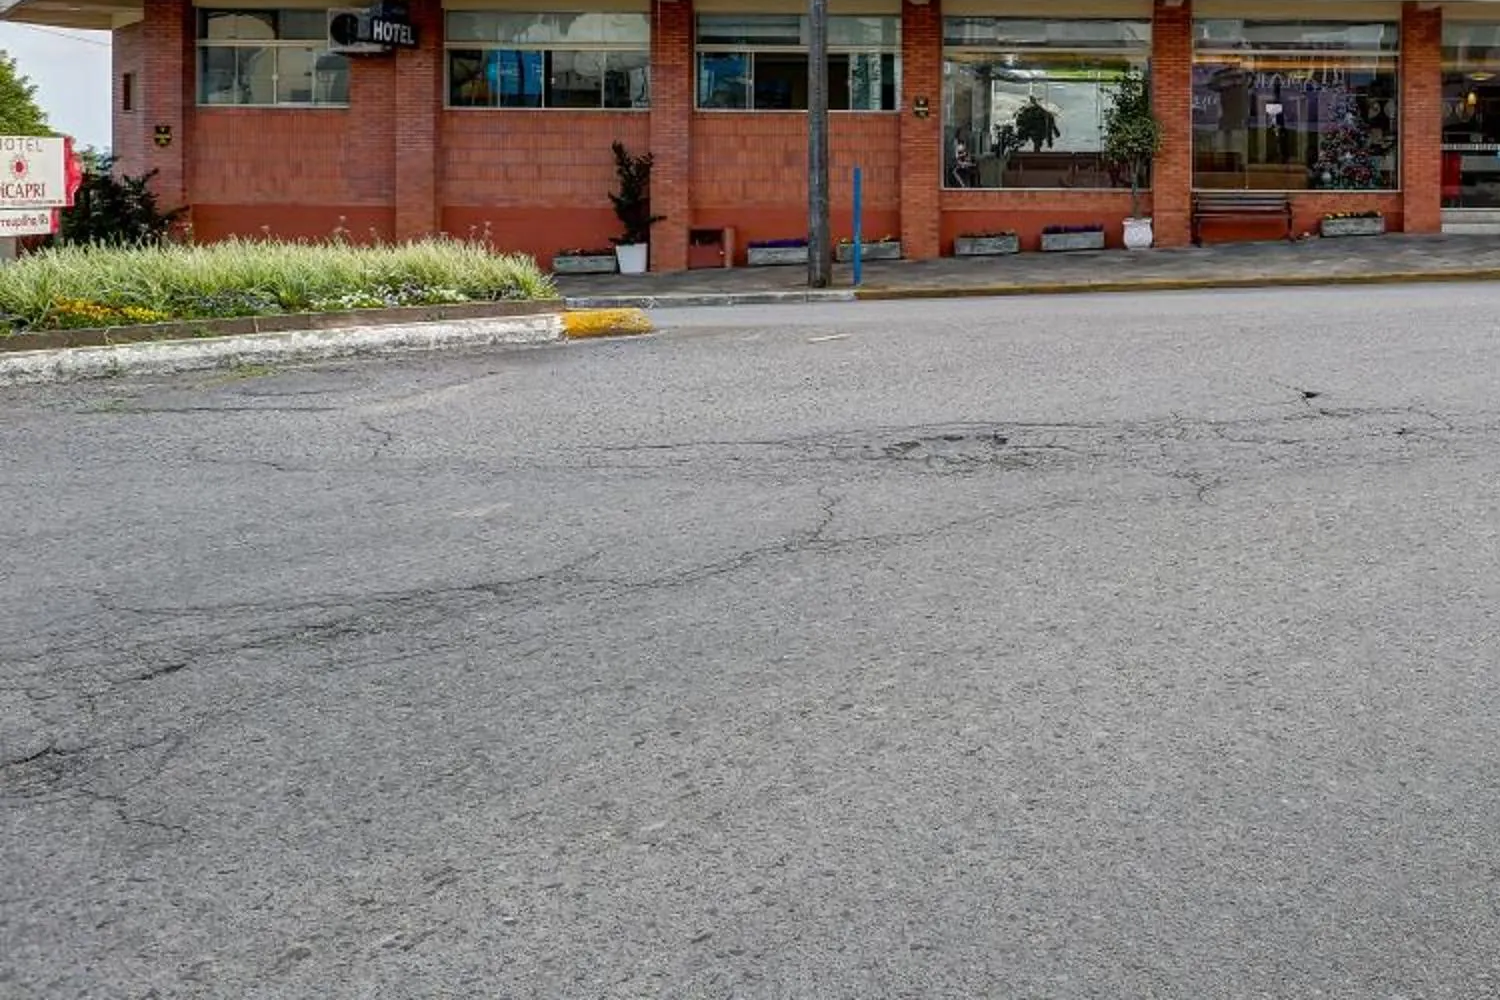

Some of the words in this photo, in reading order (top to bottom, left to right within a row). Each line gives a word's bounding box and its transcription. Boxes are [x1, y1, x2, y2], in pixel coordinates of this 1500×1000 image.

[373, 19, 415, 45] HOTEL
[0, 137, 43, 152] OTEL
[0, 183, 45, 199] iCAPRI
